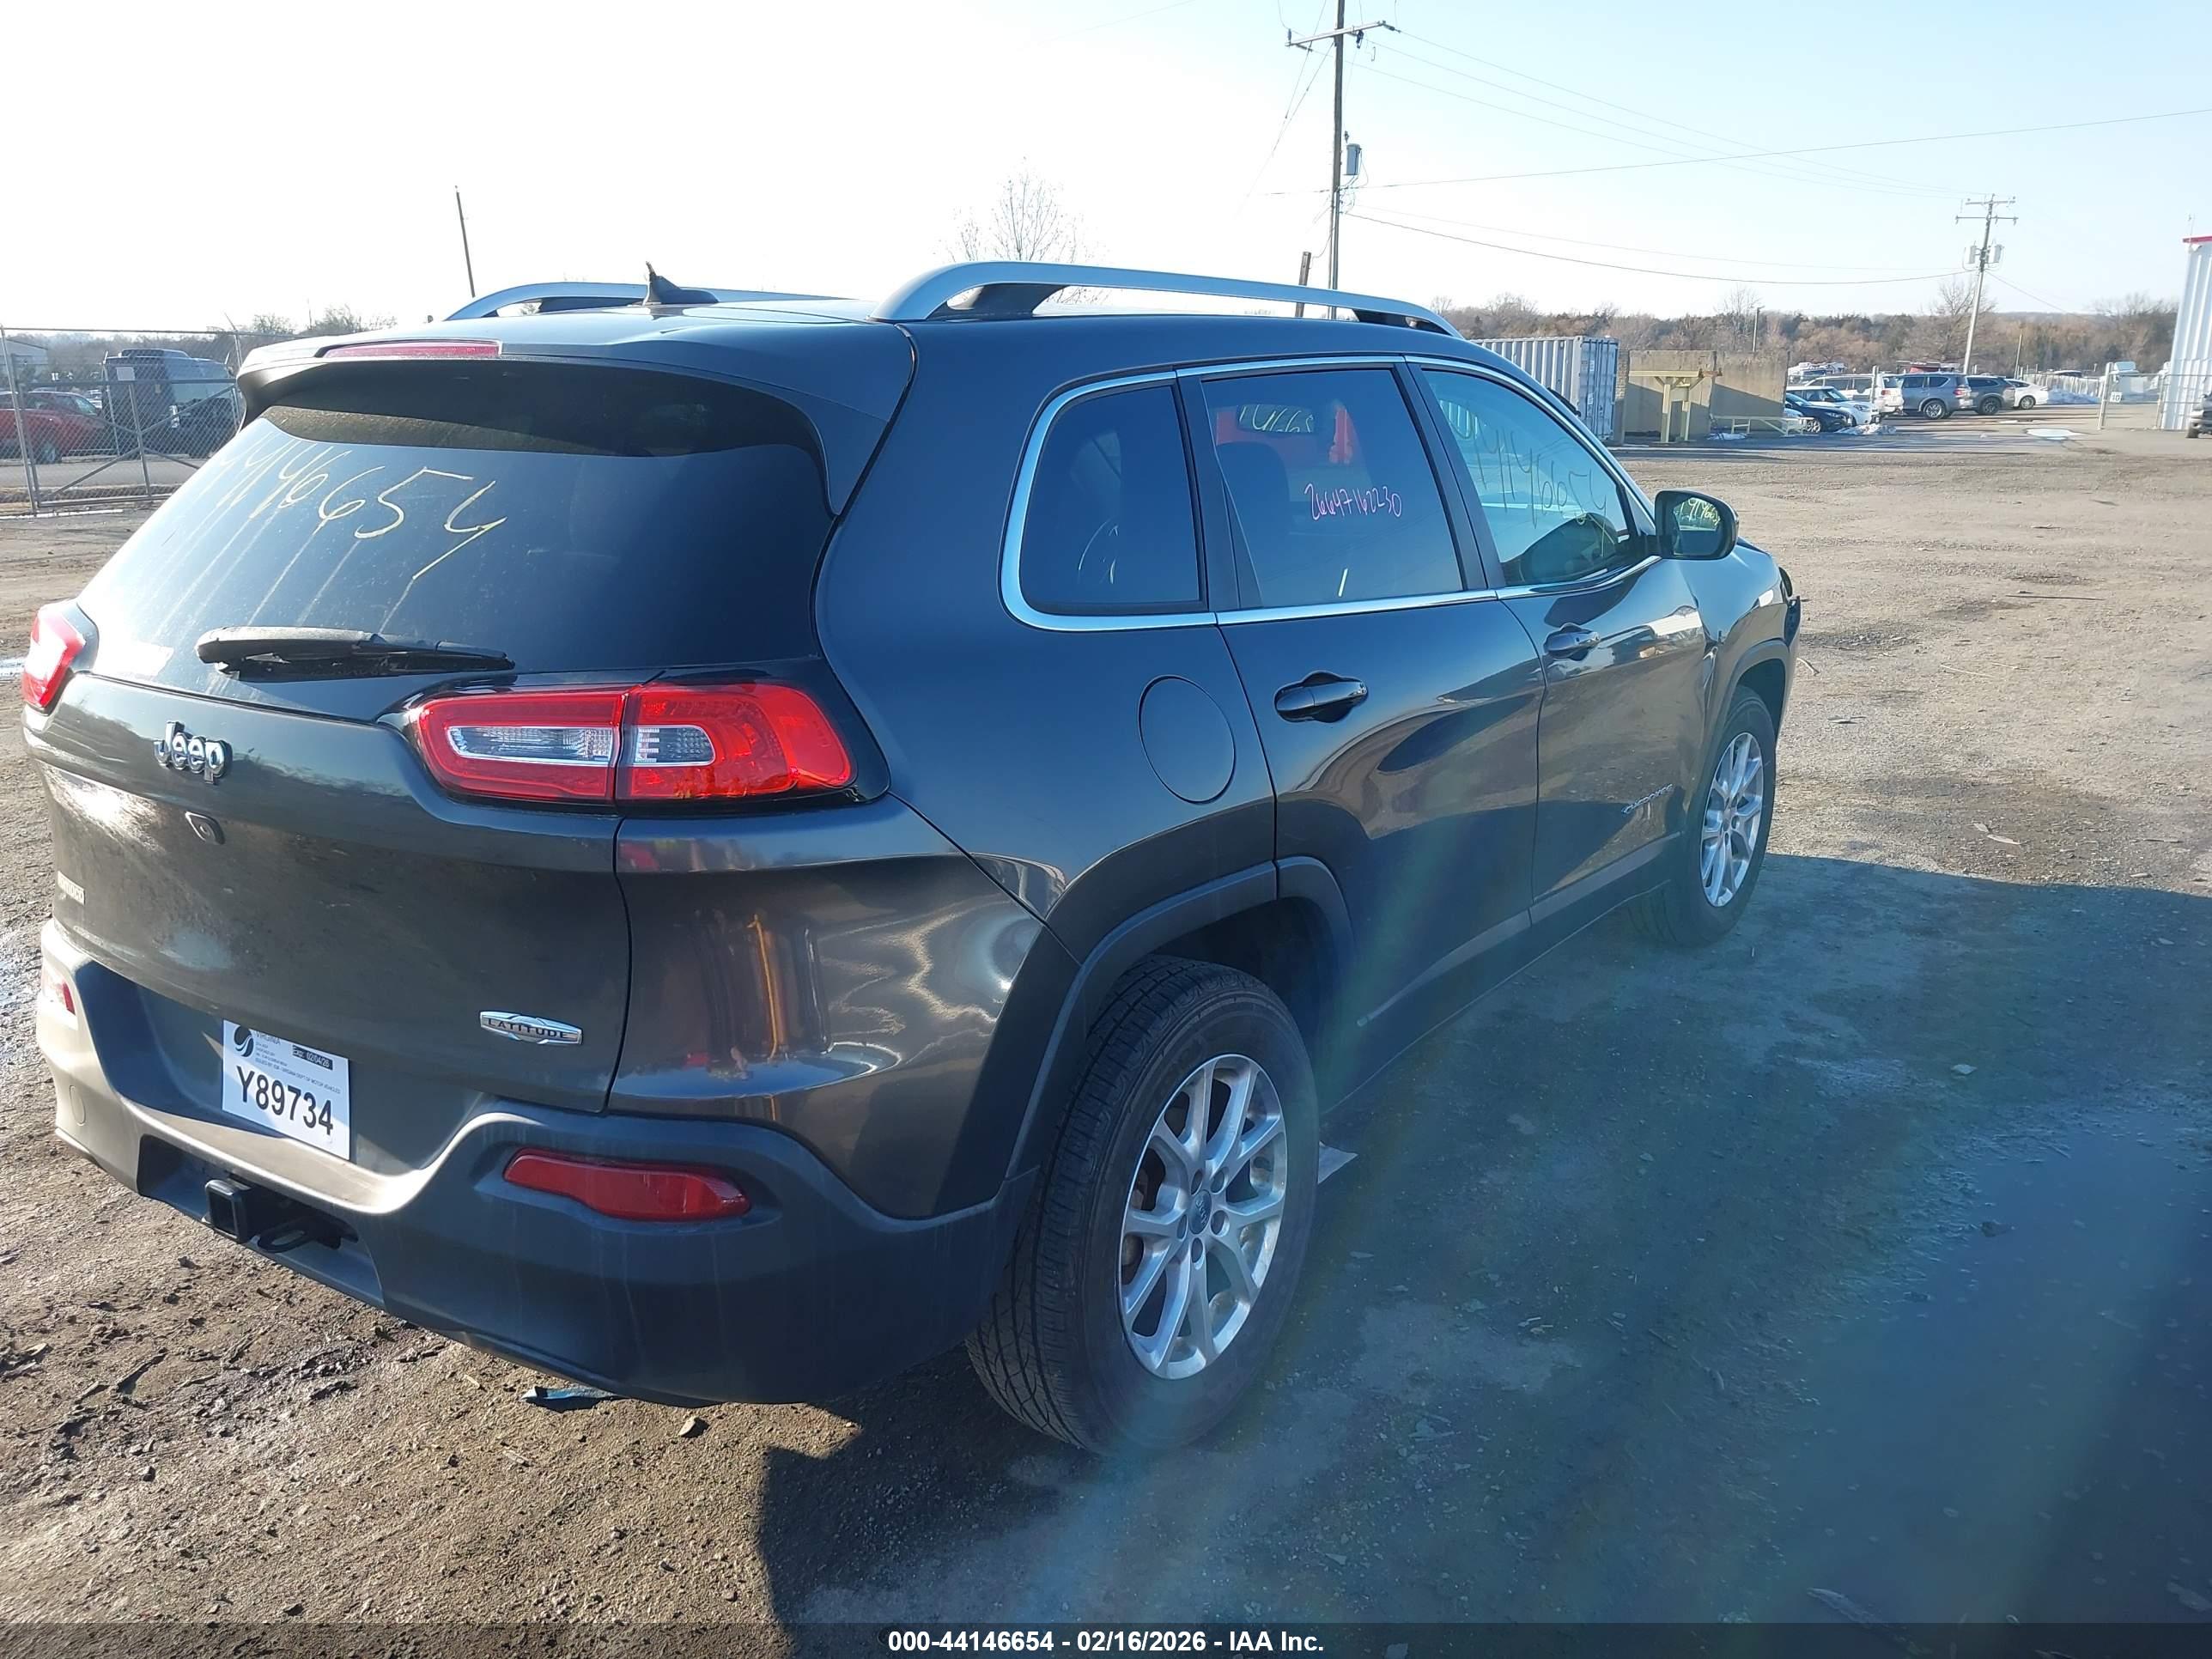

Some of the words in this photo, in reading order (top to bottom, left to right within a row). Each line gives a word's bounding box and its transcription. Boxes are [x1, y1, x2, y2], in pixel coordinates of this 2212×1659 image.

[154, 721, 233, 785] Jeep
[487, 1017, 569, 1040] LATITUDE
[236, 1065, 334, 1136] Y89734
